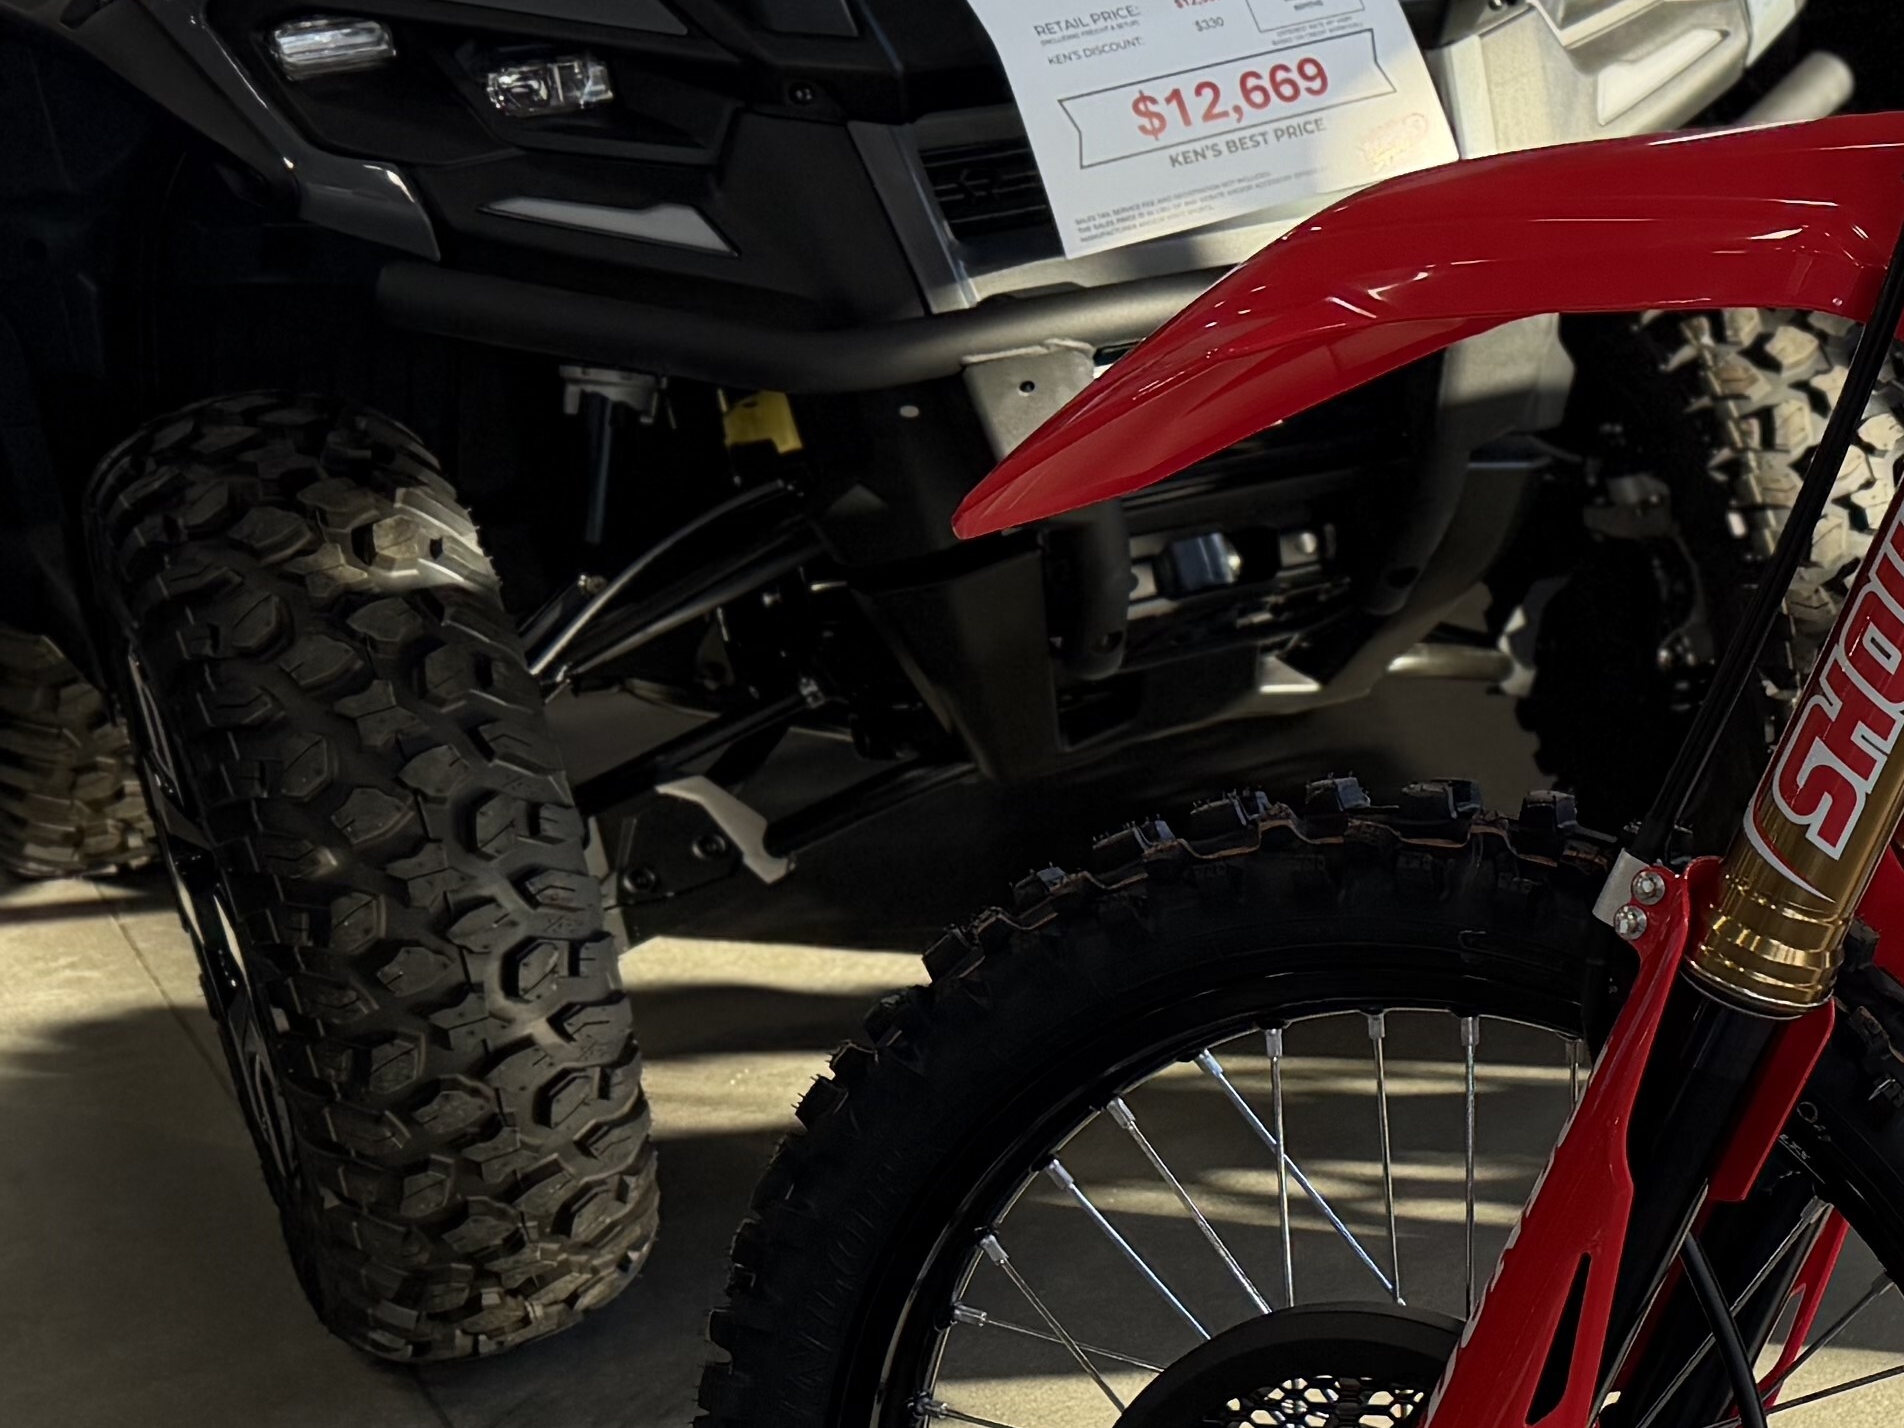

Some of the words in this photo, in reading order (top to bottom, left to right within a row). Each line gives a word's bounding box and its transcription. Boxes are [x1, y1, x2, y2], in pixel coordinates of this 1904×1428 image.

[1033, 17, 1089, 37] RETAIL
[1090, 5, 1141, 27] PRICE:
[1048, 49, 1082, 65] KEN'S
[1082, 37, 1146, 58] DISCOUNT:
[1195, 16, 1224, 32] $330
[1131, 57, 1329, 141] $12,669
[1169, 143, 1223, 168] KEN'S
[1226, 130, 1270, 155] BEST
[1275, 117, 1327, 143] PRICE
